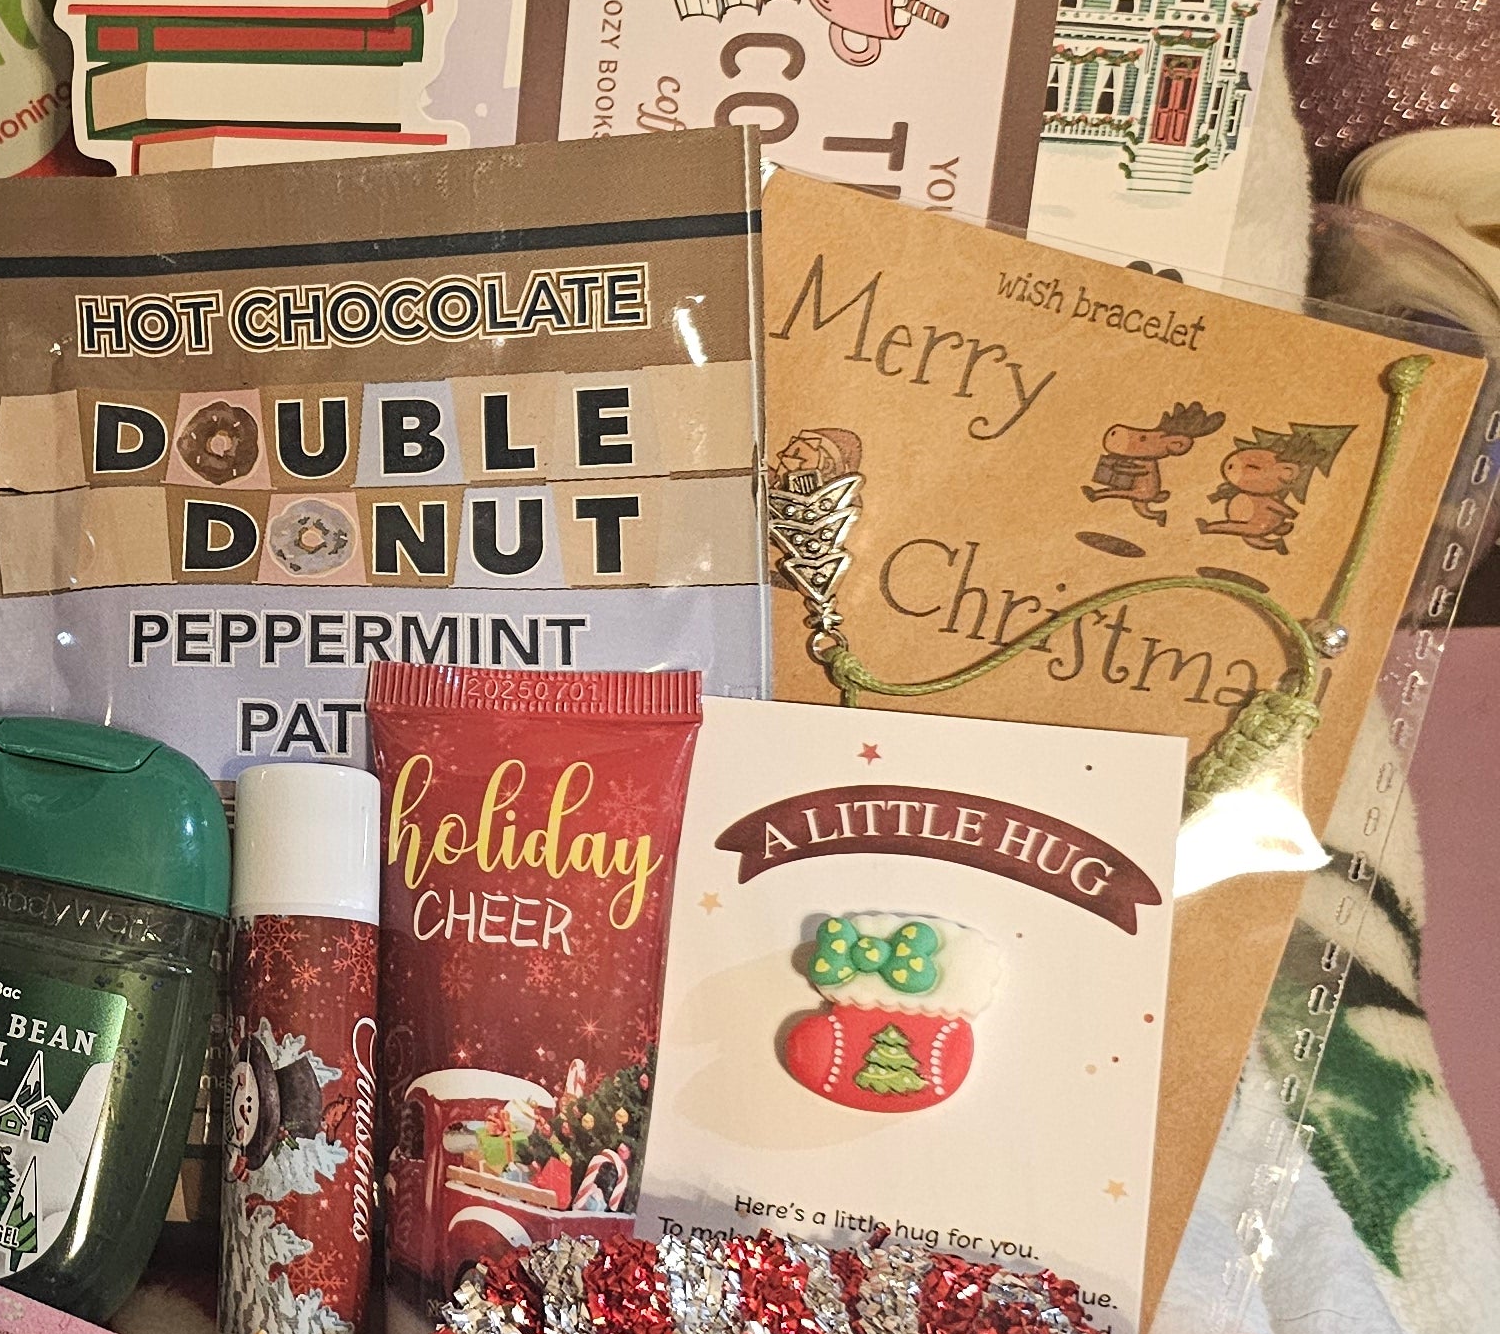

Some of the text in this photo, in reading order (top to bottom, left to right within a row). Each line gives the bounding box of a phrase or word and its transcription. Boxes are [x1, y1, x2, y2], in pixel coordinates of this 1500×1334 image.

[925, 155, 960, 212] YO
[77, 264, 649, 358] HOT CHOCOLATE
[997, 270, 1206, 354] wish bracelet
[769, 253, 1057, 442] Merry
[129, 609, 589, 668] PEPPERMINT
[467, 677, 599, 702] 20250701
[387, 754, 664, 930] holiday
[762, 799, 1115, 900] A LITTLE HUG
[412, 889, 573, 956] CHEER
[8, 1014, 98, 1058] BEAN
[351, 1017, 380, 1244] Christmas
[657, 1215, 684, 1239] To
[733, 1194, 806, 1222] Here's
[812, 1210, 827, 1226] a
[895, 1219, 940, 1250] hug
[946, 1227, 984, 1251] for
[990, 1239, 1042, 1262] you.
